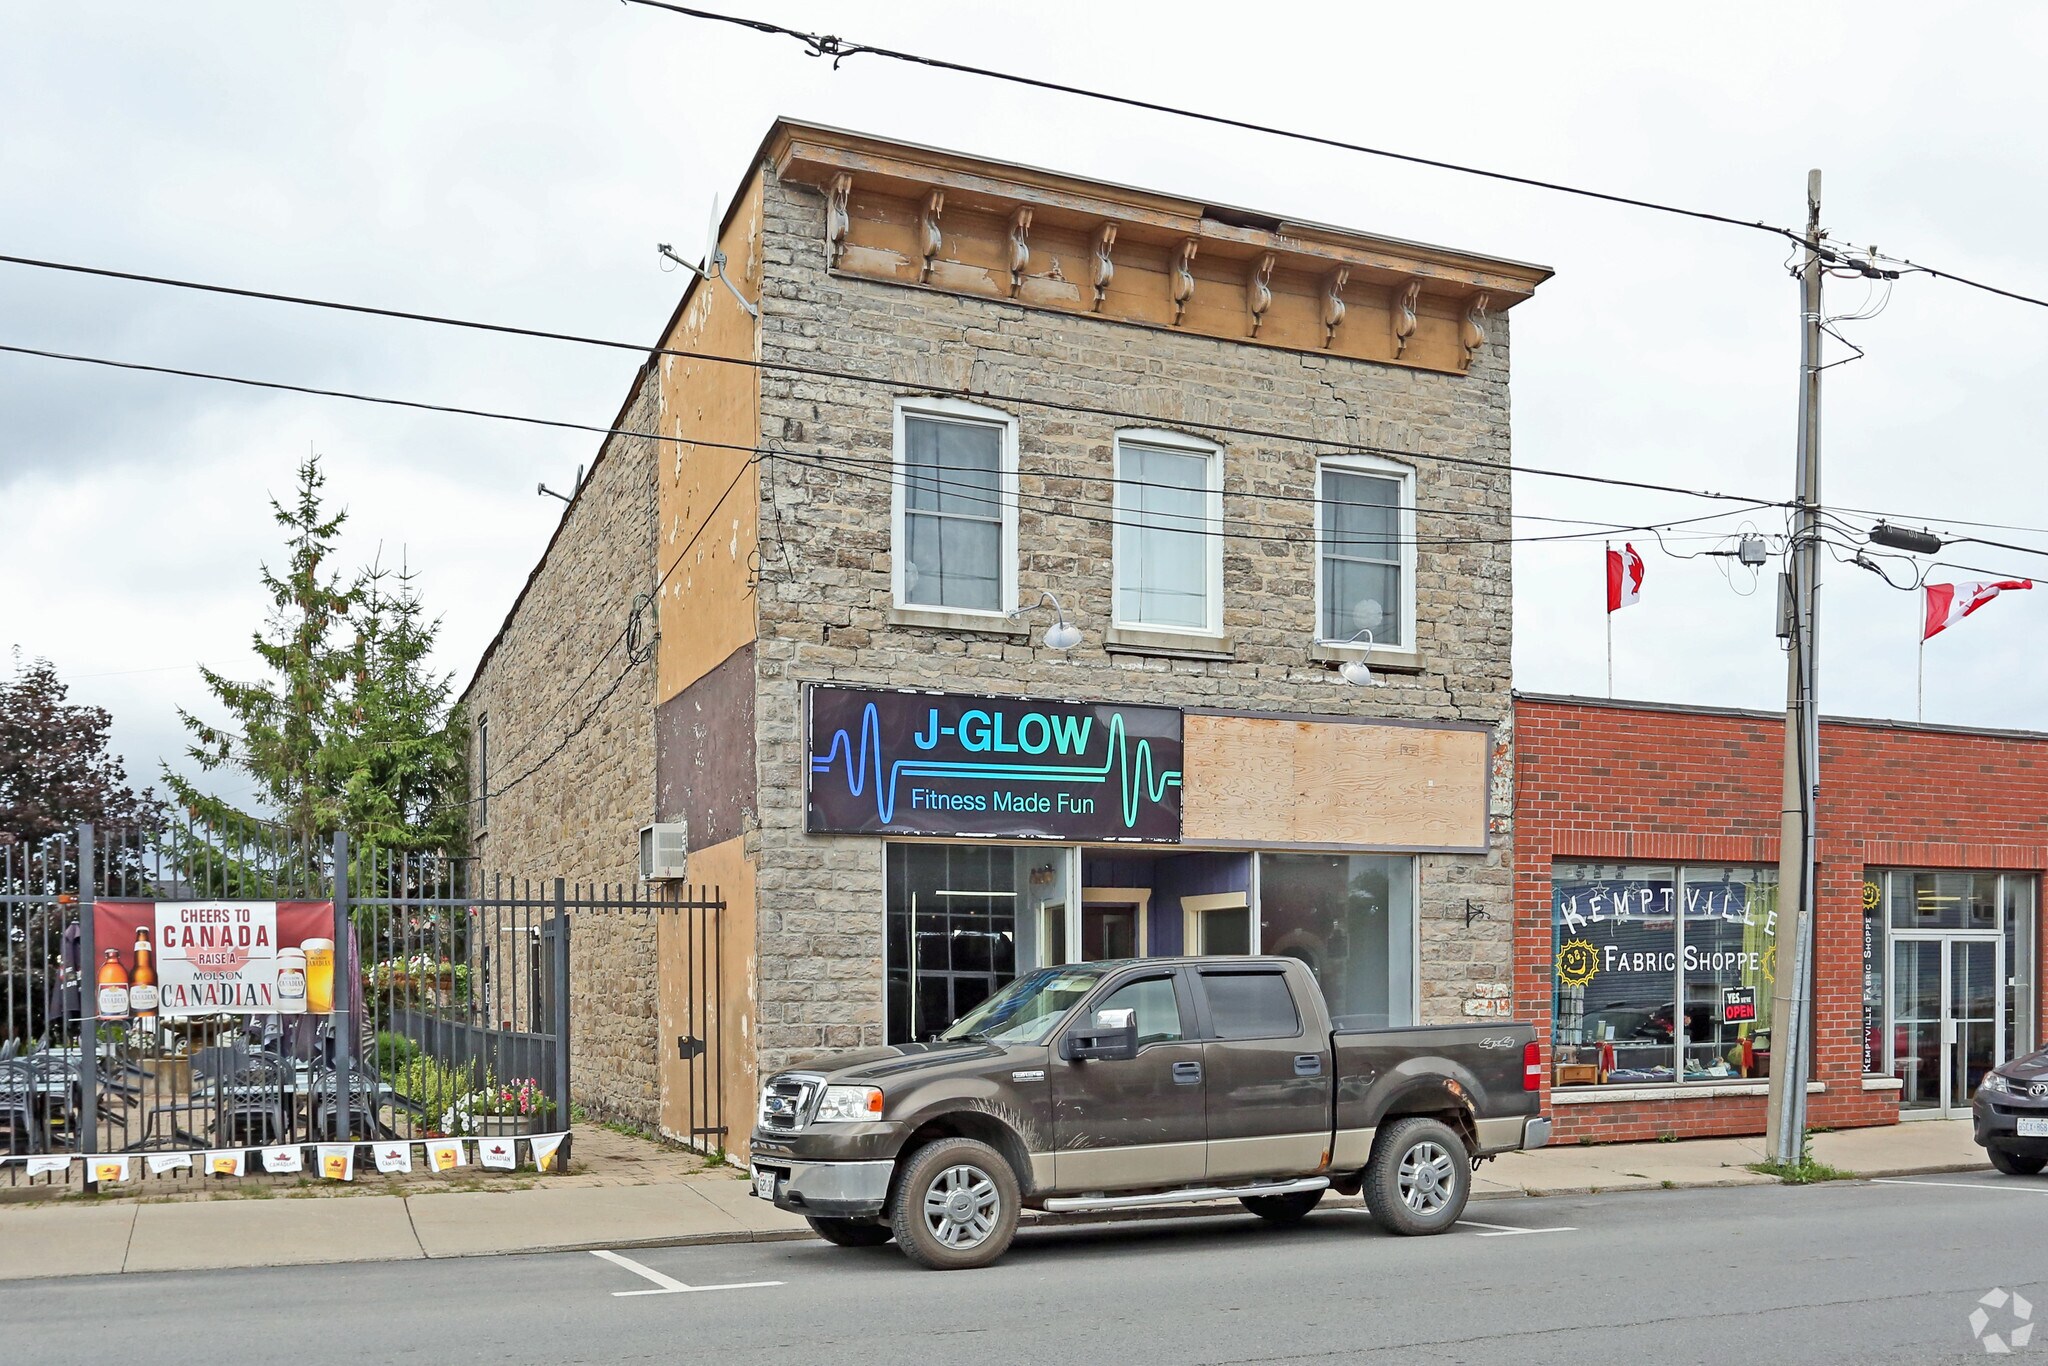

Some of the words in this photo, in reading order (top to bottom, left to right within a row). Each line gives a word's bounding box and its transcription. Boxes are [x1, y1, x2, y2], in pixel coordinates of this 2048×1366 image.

[914, 708, 1093, 755] J-GLOW
[911, 788, 987, 811] Fitness
[993, 790, 1050, 813] Made
[1057, 793, 1094, 814] Fun
[181, 909, 230, 923] CHEERS
[235, 909, 250, 923] TO
[1561, 888, 1778, 936] KEMPTVILLE
[163, 925, 269, 947] CANADA
[1863, 917, 1872, 959] SHOPPE
[199, 954, 226, 964] RAISE
[229, 953, 236, 963] A
[1604, 945, 1676, 972] FABRIC
[1683, 945, 1759, 972] SHOPPE
[193, 971, 243, 981] MOLSON
[1863, 964, 1872, 1001] FABRIC
[161, 983, 273, 1008] CANADIAN
[1727, 992, 1740, 1004] YES
[1726, 1004, 1754, 1019] OPEN
[1479, 1036, 1515, 1050] 4x4
[1863, 1006, 1872, 1072] KEMPTVILLE
